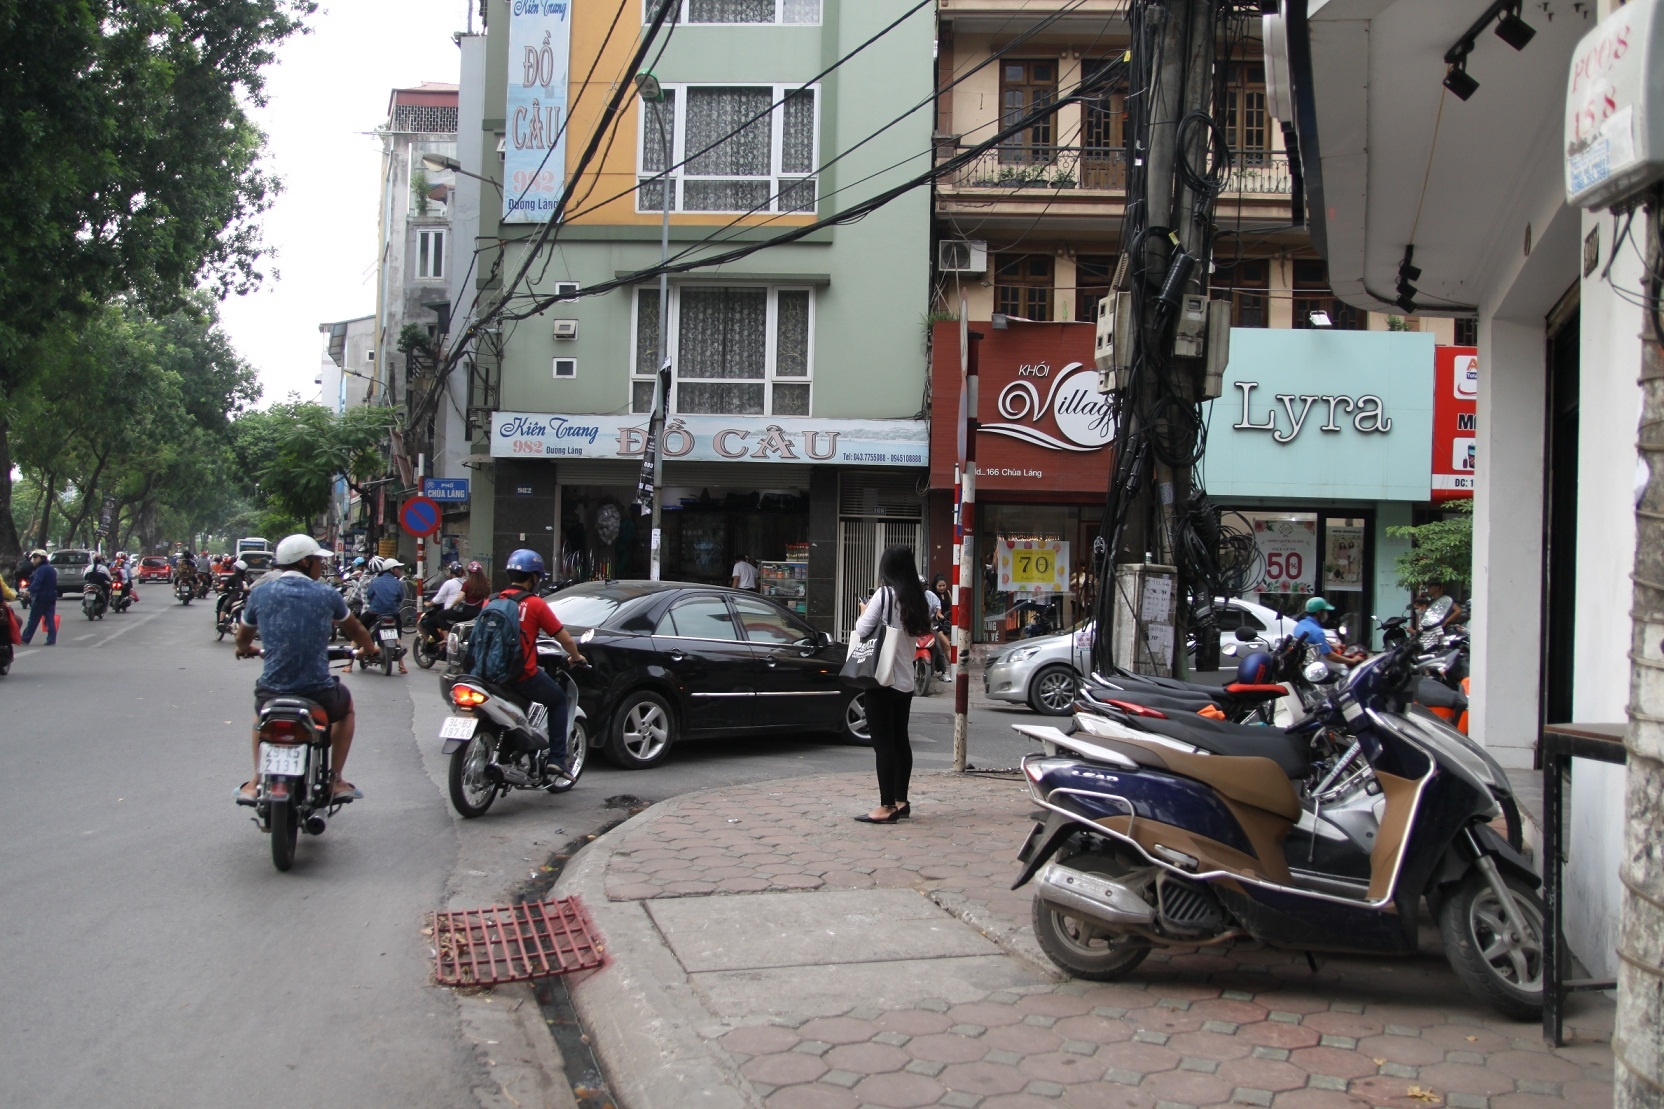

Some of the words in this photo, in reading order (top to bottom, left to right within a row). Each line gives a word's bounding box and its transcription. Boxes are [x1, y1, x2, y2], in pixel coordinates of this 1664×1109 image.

[523, 30, 554, 88] ĐỒ
[512, 98, 561, 150] CÂU
[513, 169, 555, 193] 982
[1018, 361, 1050, 377] KHÓI
[1233, 381, 1393, 443] Lyra
[500, 417, 546, 438] Kiên
[549, 417, 599, 444] Trang
[615, 418, 696, 457] ĐỒ
[712, 424, 842, 460] CÂU
[513, 440, 543, 454] 982
[1023, 469, 1042, 479] Láng
[427, 487, 446, 498] CHÙA
[447, 487, 465, 498] LÁNG
[1019, 556, 1049, 574] 70
